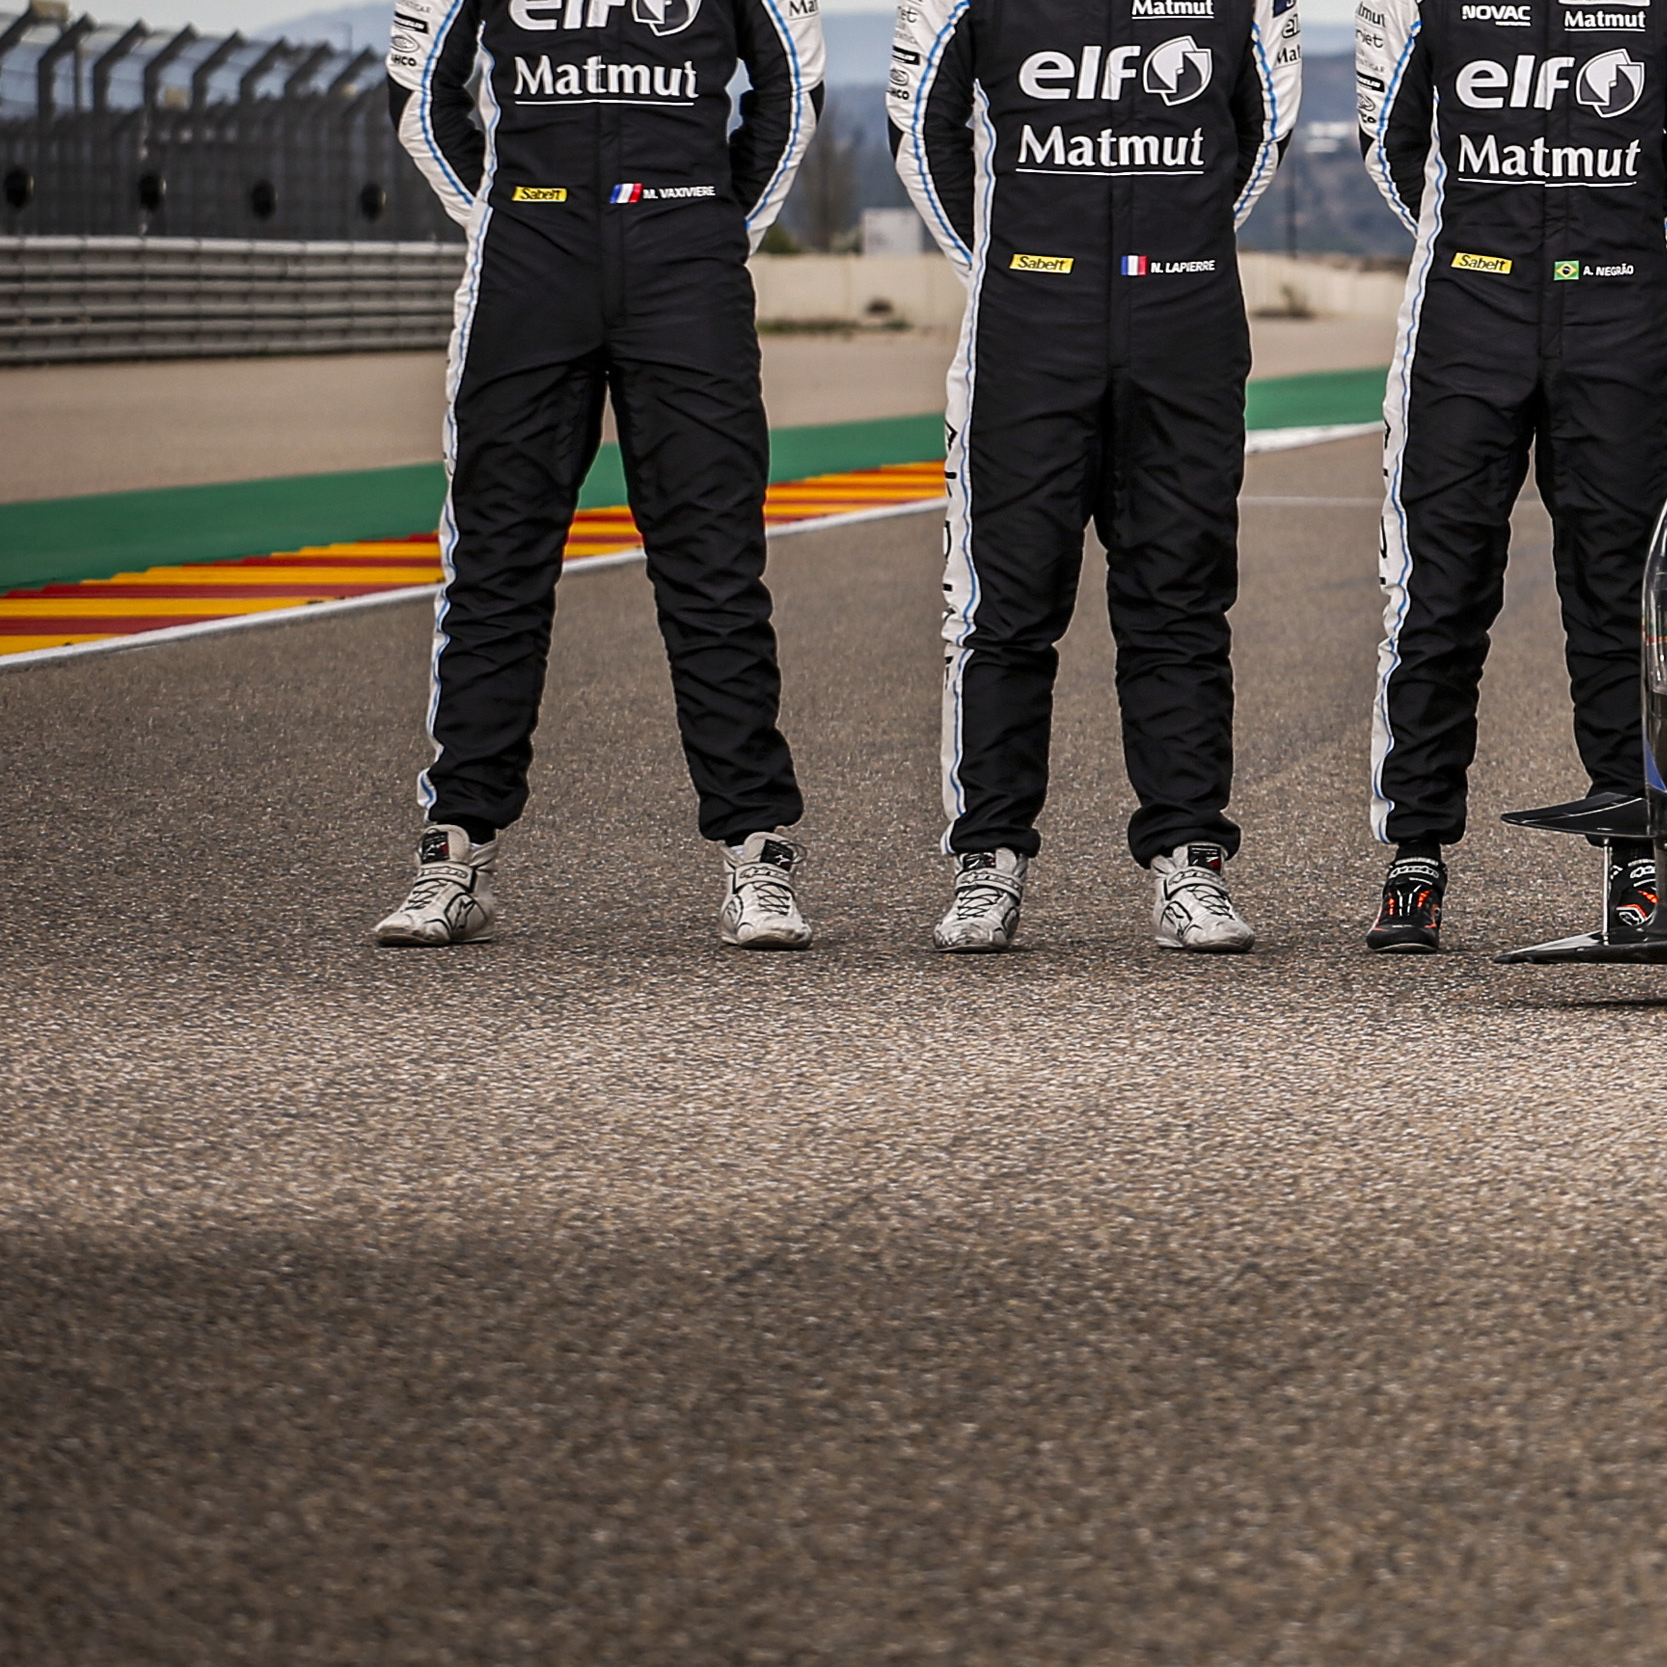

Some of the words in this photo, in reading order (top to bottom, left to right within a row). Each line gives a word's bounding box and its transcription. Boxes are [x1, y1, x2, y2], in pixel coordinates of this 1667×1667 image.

[1461, 4, 1531, 21] NOVAC
[1564, 10, 1646, 28] Matmut
[513, 54, 699, 100] Matmut
[1018, 45, 1142, 102] elf
[1455, 54, 1575, 111] elf
[1017, 124, 1205, 167] Matmut
[1457, 133, 1642, 178] Matmut
[1017, 255, 1066, 271] Sabelt
[1165, 260, 1216, 273] LAPIERRE
[1459, 254, 1506, 272] Sabelt
